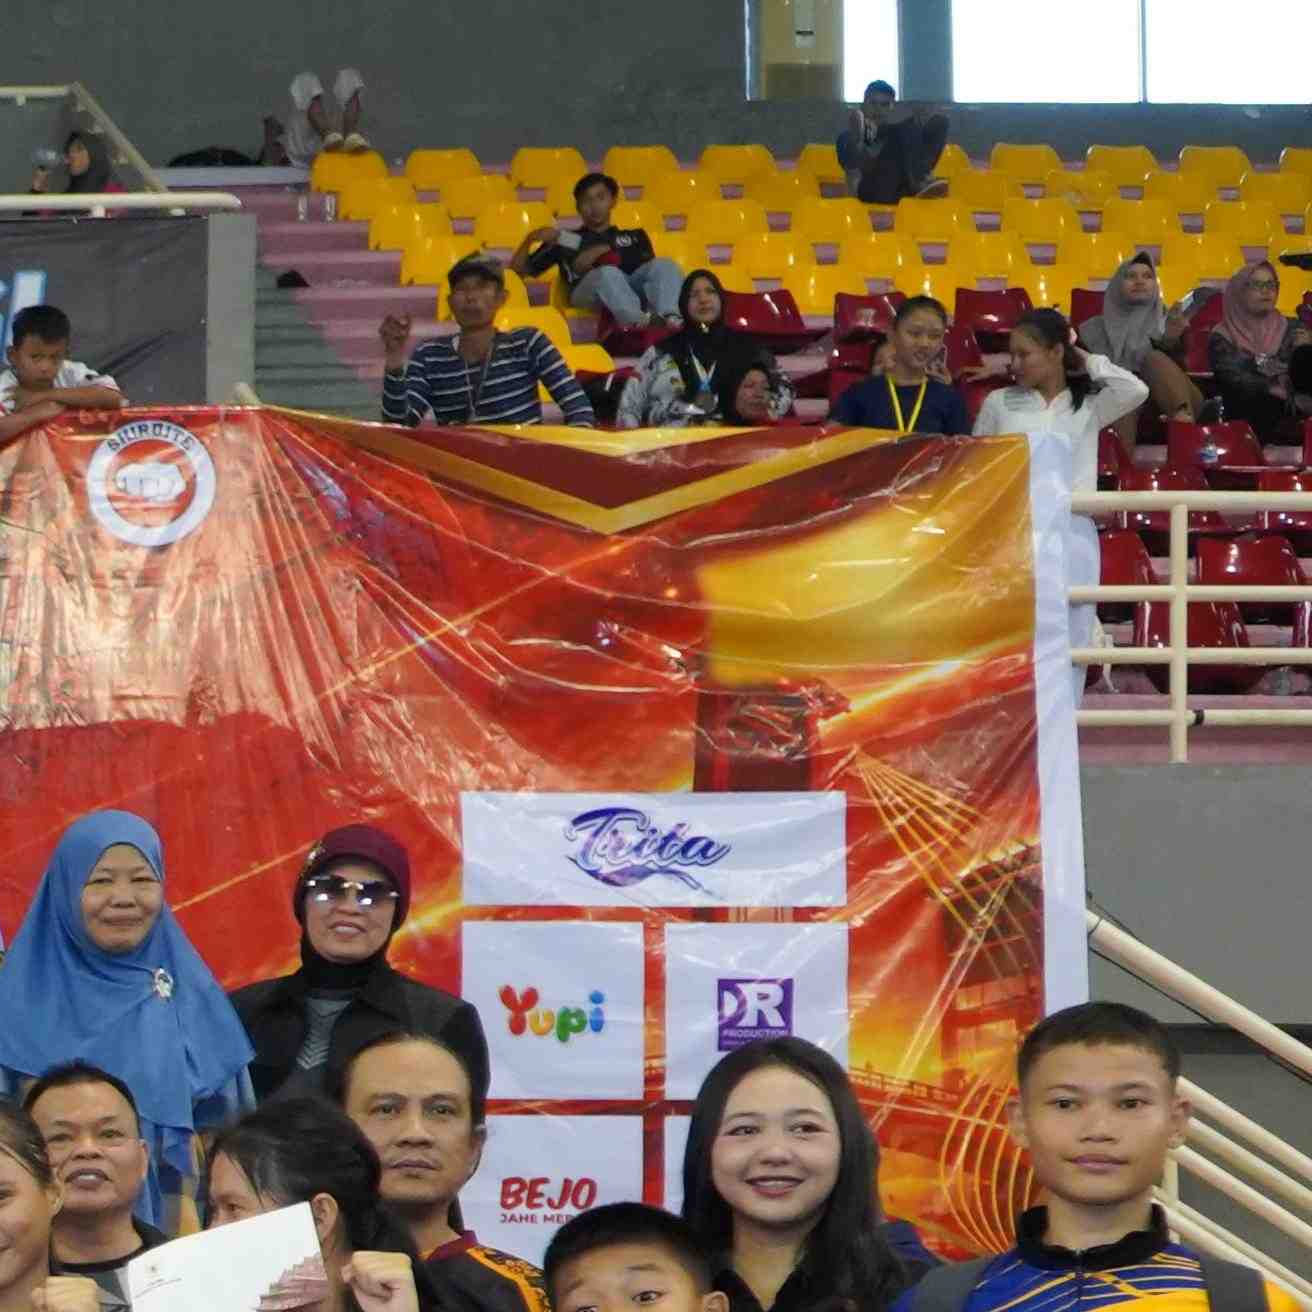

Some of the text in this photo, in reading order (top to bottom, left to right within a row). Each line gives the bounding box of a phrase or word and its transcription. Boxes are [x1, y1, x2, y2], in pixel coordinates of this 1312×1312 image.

[566, 807, 732, 870] Trita
[498, 984, 605, 1042] Yupi
[500, 1176, 598, 1210] BEJO
[500, 1213, 537, 1225] JAHE
